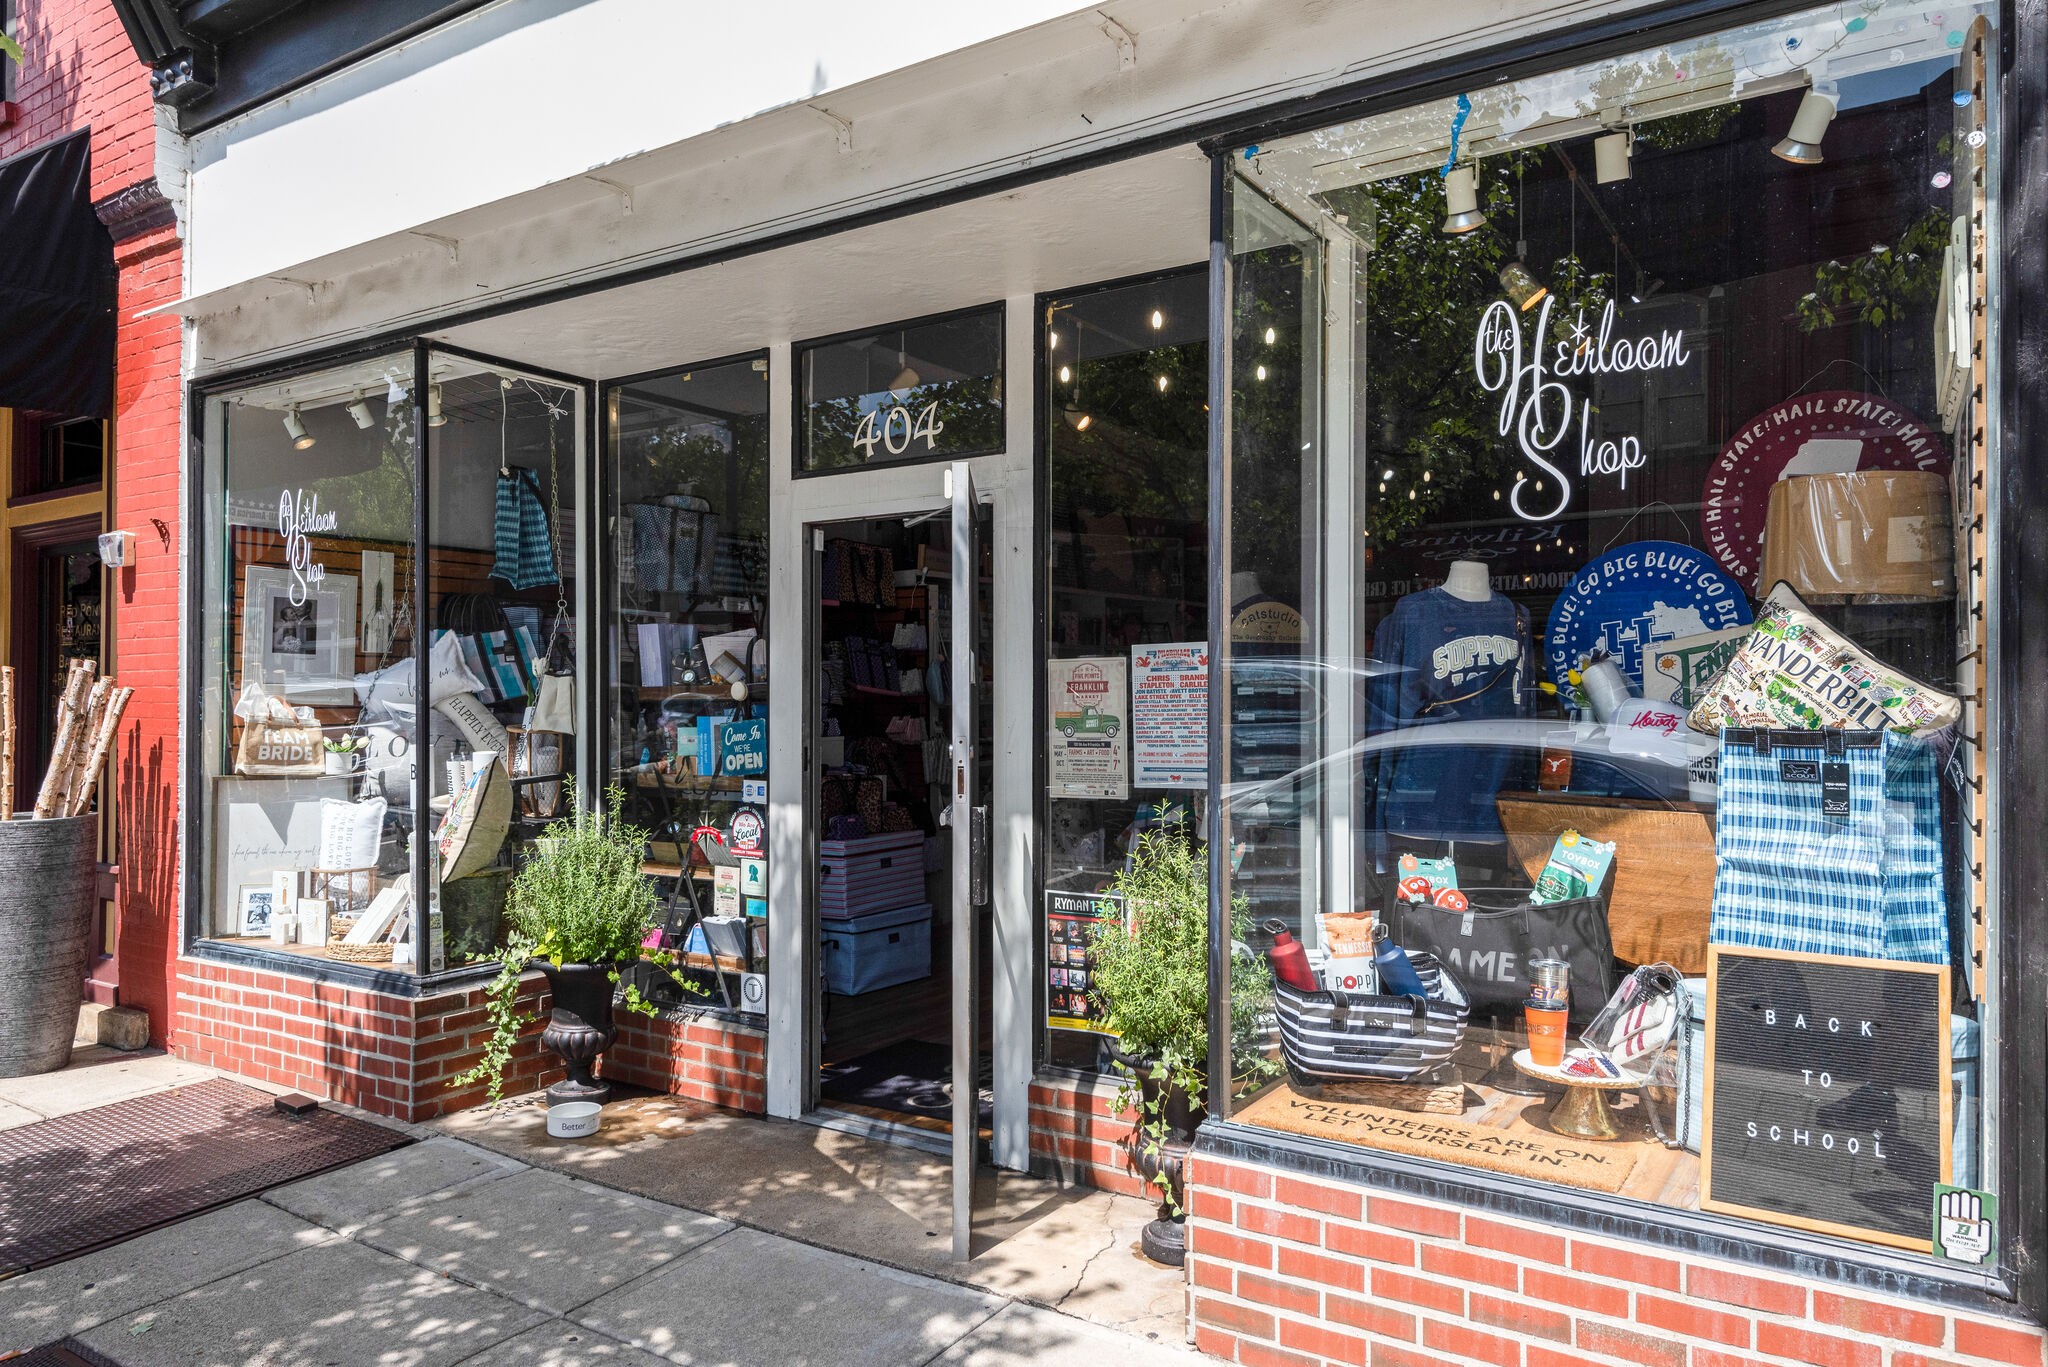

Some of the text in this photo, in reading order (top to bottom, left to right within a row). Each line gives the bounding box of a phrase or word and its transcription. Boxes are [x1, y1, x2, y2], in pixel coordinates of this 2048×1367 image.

[1475, 296, 1690, 437] the Heirloom
[853, 401, 944, 458] 404
[1511, 382, 1646, 521] Shop
[1706, 398, 1937, 578] STATE! HAIL STATE! HAIL STATE! HAIL
[280, 489, 338, 561] Heirloom
[289, 535, 325, 606] Shop
[1603, 553, 1638, 578] BIG
[1644, 551, 1701, 580] BLUE!
[1577, 572, 1599, 596] GO
[1697, 572, 1726, 597] GO
[80, 603, 100, 617] PON
[1241, 608, 1300, 628] catstudio
[1552, 595, 1580, 645] BLUE!
[55, 623, 100, 638] RESTAURAN
[1433, 635, 1524, 679] SUPPO
[1552, 650, 1569, 684] BIG
[1071, 682, 1104, 691] FRANKLIN
[1748, 630, 1898, 731] VANDERBILT
[1804, 690, 1826, 709] Founded
[449, 697, 485, 735] HAPPILY
[1628, 709, 1682, 737] Howdy
[1740, 712, 1768, 720] MEMORIAL
[263, 730, 310, 744] TEAM
[725, 725, 761, 746] Come In
[734, 744, 751, 752] WE'RE
[258, 745, 313, 761] BRIDE
[726, 752, 763, 770] OPEN
[734, 824, 759, 841] Local
[1562, 850, 1601, 870] TOYBOX
[1054, 896, 1089, 912] RYMAN
[1765, 1009, 1873, 1037] BACK
[1802, 1069, 1832, 1088] TO
[561, 1122, 586, 1131] Better
[1289, 1100, 1611, 1166] VOLUNTEERS ARE ON.
[1304, 1112, 1568, 1168] LET YOURSELF IN.
[1747, 1121, 1887, 1159] SCHOOL
